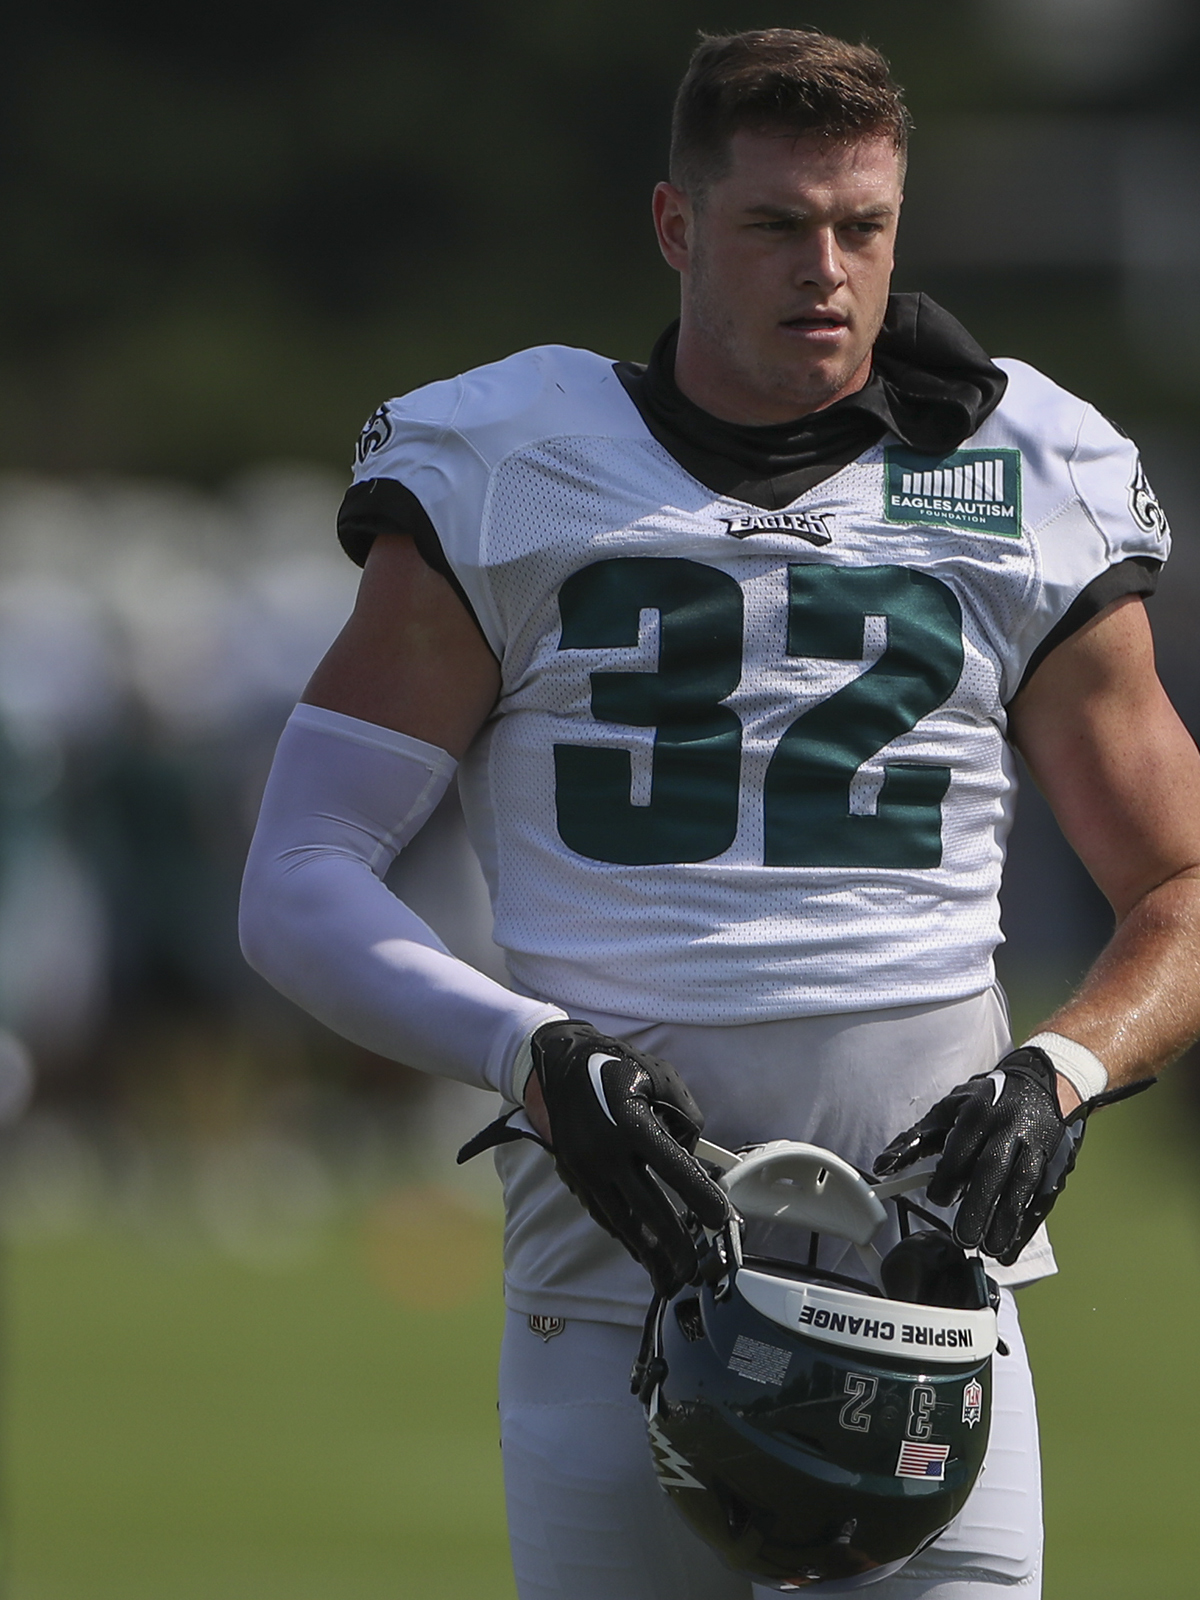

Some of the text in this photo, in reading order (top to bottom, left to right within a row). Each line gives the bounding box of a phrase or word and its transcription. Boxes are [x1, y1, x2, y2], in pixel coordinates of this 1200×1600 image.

[891, 495, 1014, 518] EAGLES AUTISM
[920, 509, 986, 524] FOUNDATION
[724, 511, 836, 545] EAGLES
[553, 557, 965, 869] 32
[798, 1305, 973, 1348] INSPIRE CHANGE
